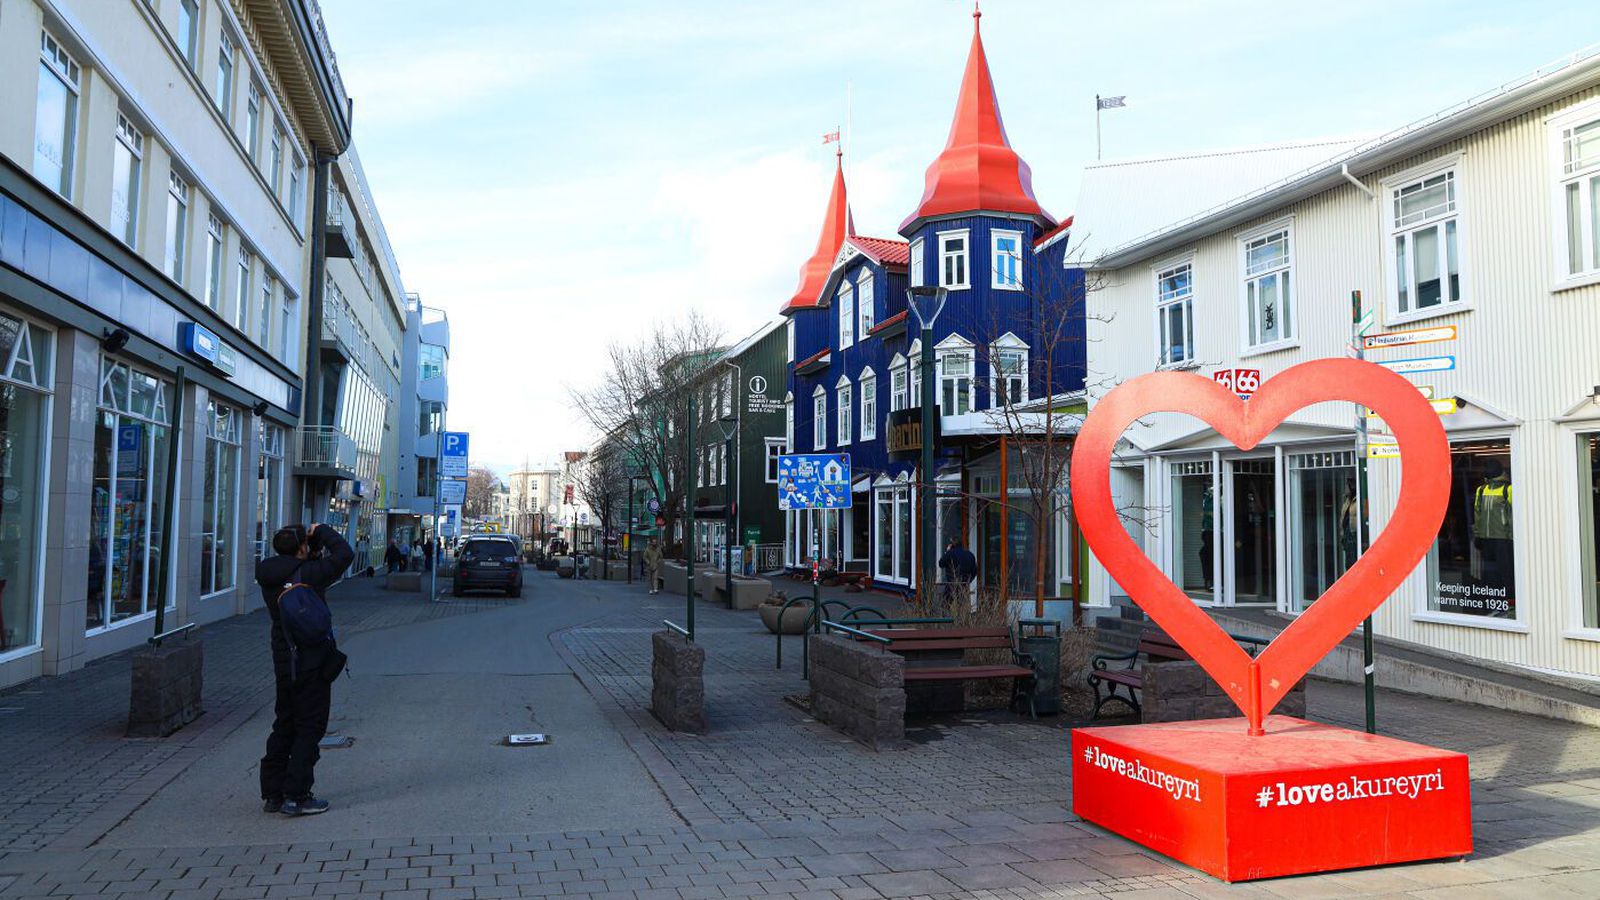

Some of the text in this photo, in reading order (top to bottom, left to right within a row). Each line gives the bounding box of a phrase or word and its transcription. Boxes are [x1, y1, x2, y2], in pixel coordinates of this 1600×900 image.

[1436, 582, 1506, 597] Keeping Iceland
[1434, 597, 1509, 611] warm since 1926
